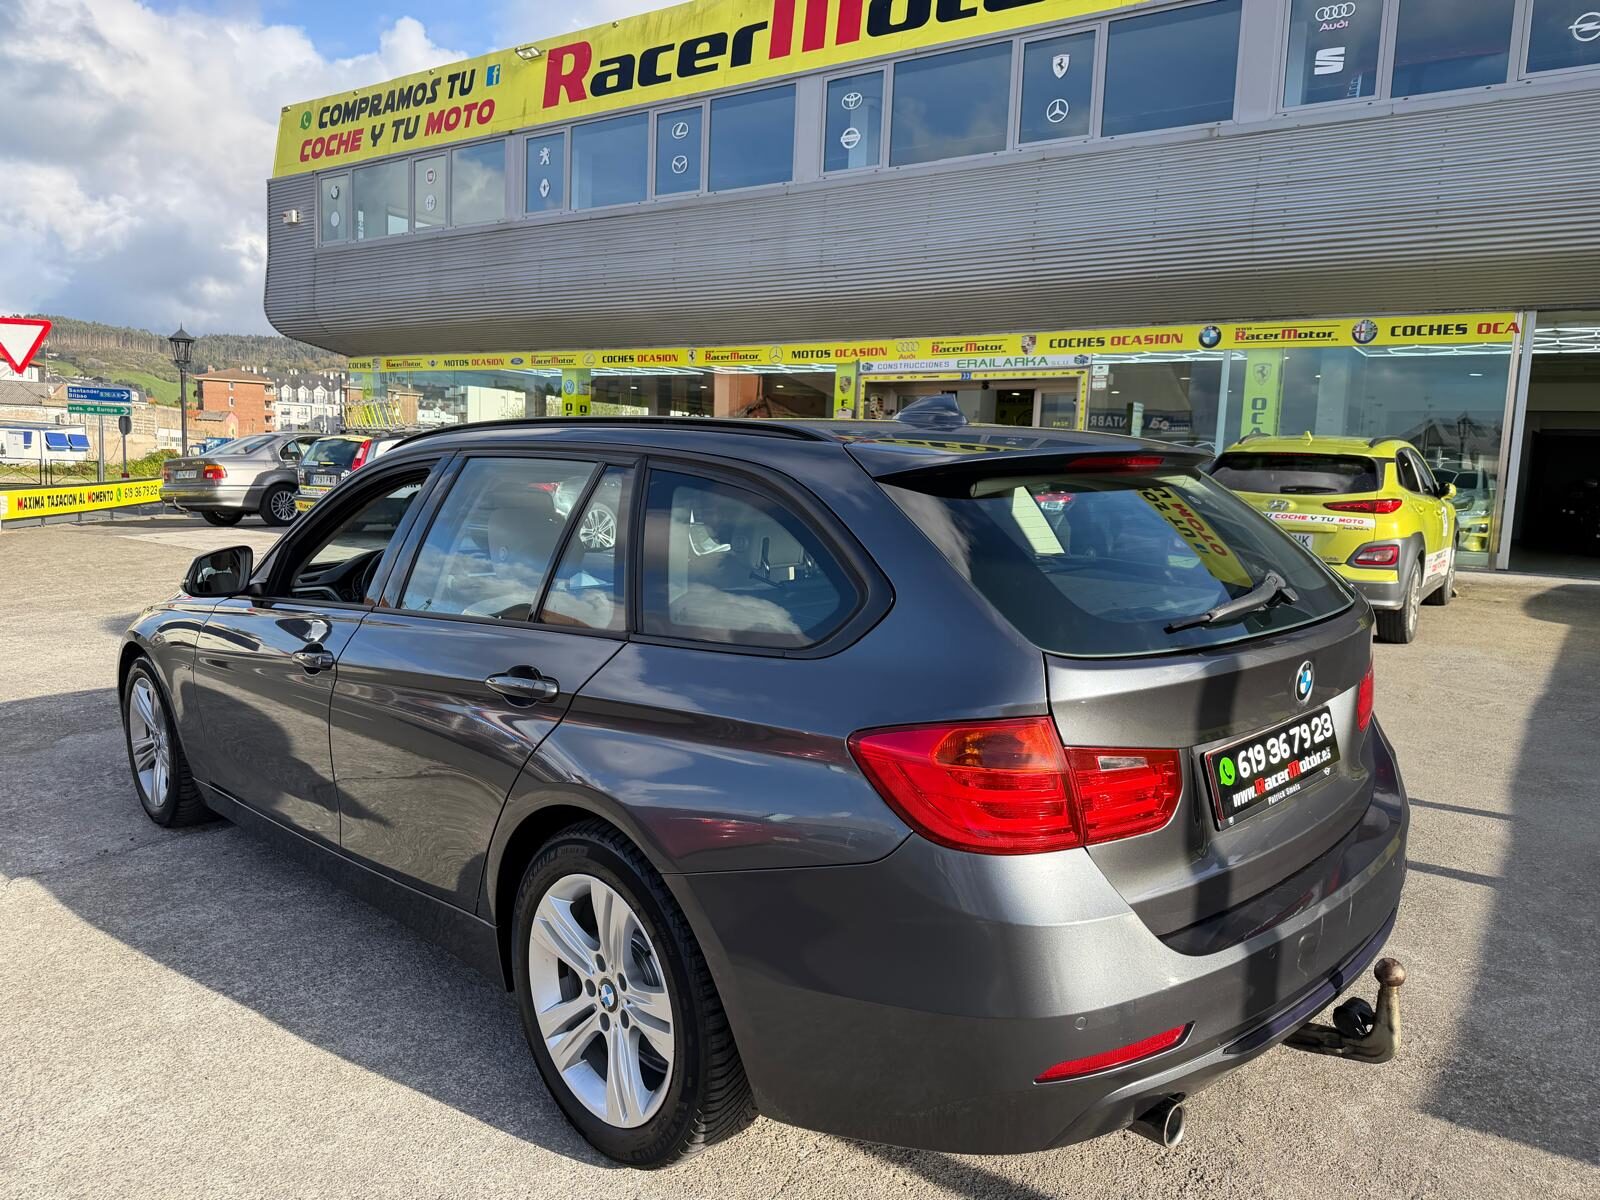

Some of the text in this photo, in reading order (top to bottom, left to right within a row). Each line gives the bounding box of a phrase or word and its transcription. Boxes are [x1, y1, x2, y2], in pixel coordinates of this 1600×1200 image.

[1319, 20, 1349, 32] Audi
[318, 69, 476, 129] COMPRAMOS TU
[299, 98, 496, 162] COCHE Y TU MOTO
[1235, 329, 1335, 340] RacerMotor
[1390, 323, 1468, 337] COCHES
[1049, 333, 1183, 349] COCHES OCASION
[791, 347, 888, 359] MOTOS OCASION
[931, 343, 1004, 353] RacerMotor
[443, 359, 469, 367] MOTOS
[471, 358, 504, 366] OCASION
[602, 353, 679, 363] COCHES OCASION
[705, 352, 760, 361] RacerMotor
[877, 361, 950, 370] CONSTRUCCIONES
[956, 356, 1049, 368] ERAILARKA
[17, 485, 158, 511] MAXIMA TASACION AL MOMENTO 619 36 79 23
[1274, 513, 1308, 521] COCHE
[1238, 712, 1333, 779] 619 36 79 23
[1232, 747, 1332, 808] www.RacerMotor.es
